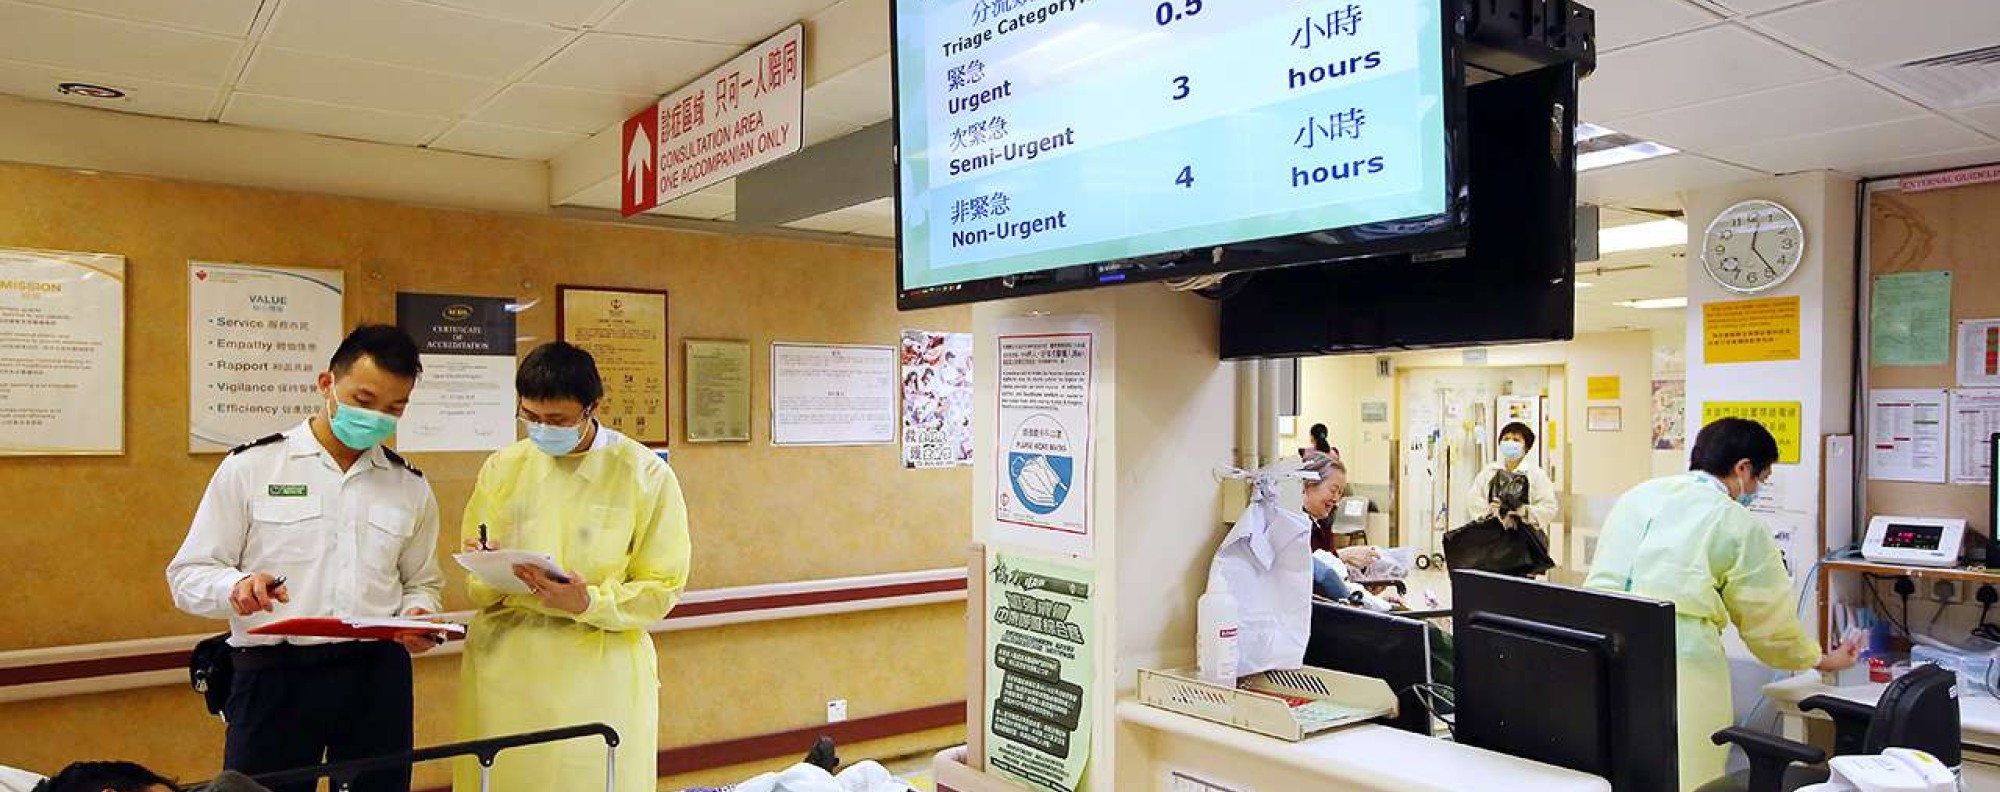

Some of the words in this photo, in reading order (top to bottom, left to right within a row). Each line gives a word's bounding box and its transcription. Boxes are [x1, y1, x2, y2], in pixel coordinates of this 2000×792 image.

[1156, 0, 1202, 26] 0.5
[1290, 4, 1362, 49] 小時
[943, 29, 992, 57] Triage
[948, 59, 985, 92] 緊急
[1289, 51, 1381, 88] hours
[661, 89, 705, 144] 診症區域
[715, 40, 796, 118] 只可一人陪同
[948, 80, 1012, 114] Urgent
[1172, 75, 1190, 100] 3
[661, 126, 730, 171] CONSULTATION
[733, 110, 764, 138] AREA
[950, 116, 1008, 152] 次緊急
[1294, 108, 1366, 149] 小時
[661, 171, 678, 193] ONE
[758, 123, 790, 153] ONLY
[950, 127, 1074, 176] Semi-Urgent
[1174, 165, 1194, 188] 4
[1292, 156, 1384, 187] hours
[952, 192, 1010, 225] 非緊急
[952, 210, 1067, 247] Non-Urgent
[0, 281, 62, 292] MISSION
[249, 295, 287, 305] VALUE
[216, 316, 264, 328] Service
[432, 326, 482, 334] CERTIFICATE
[216, 338, 273, 352] Empathy
[427, 341, 488, 350] ACCREDITATION
[216, 360, 269, 372] Rapport
[216, 382, 275, 393] Vigilance
[216, 402, 278, 416] Efficiency
